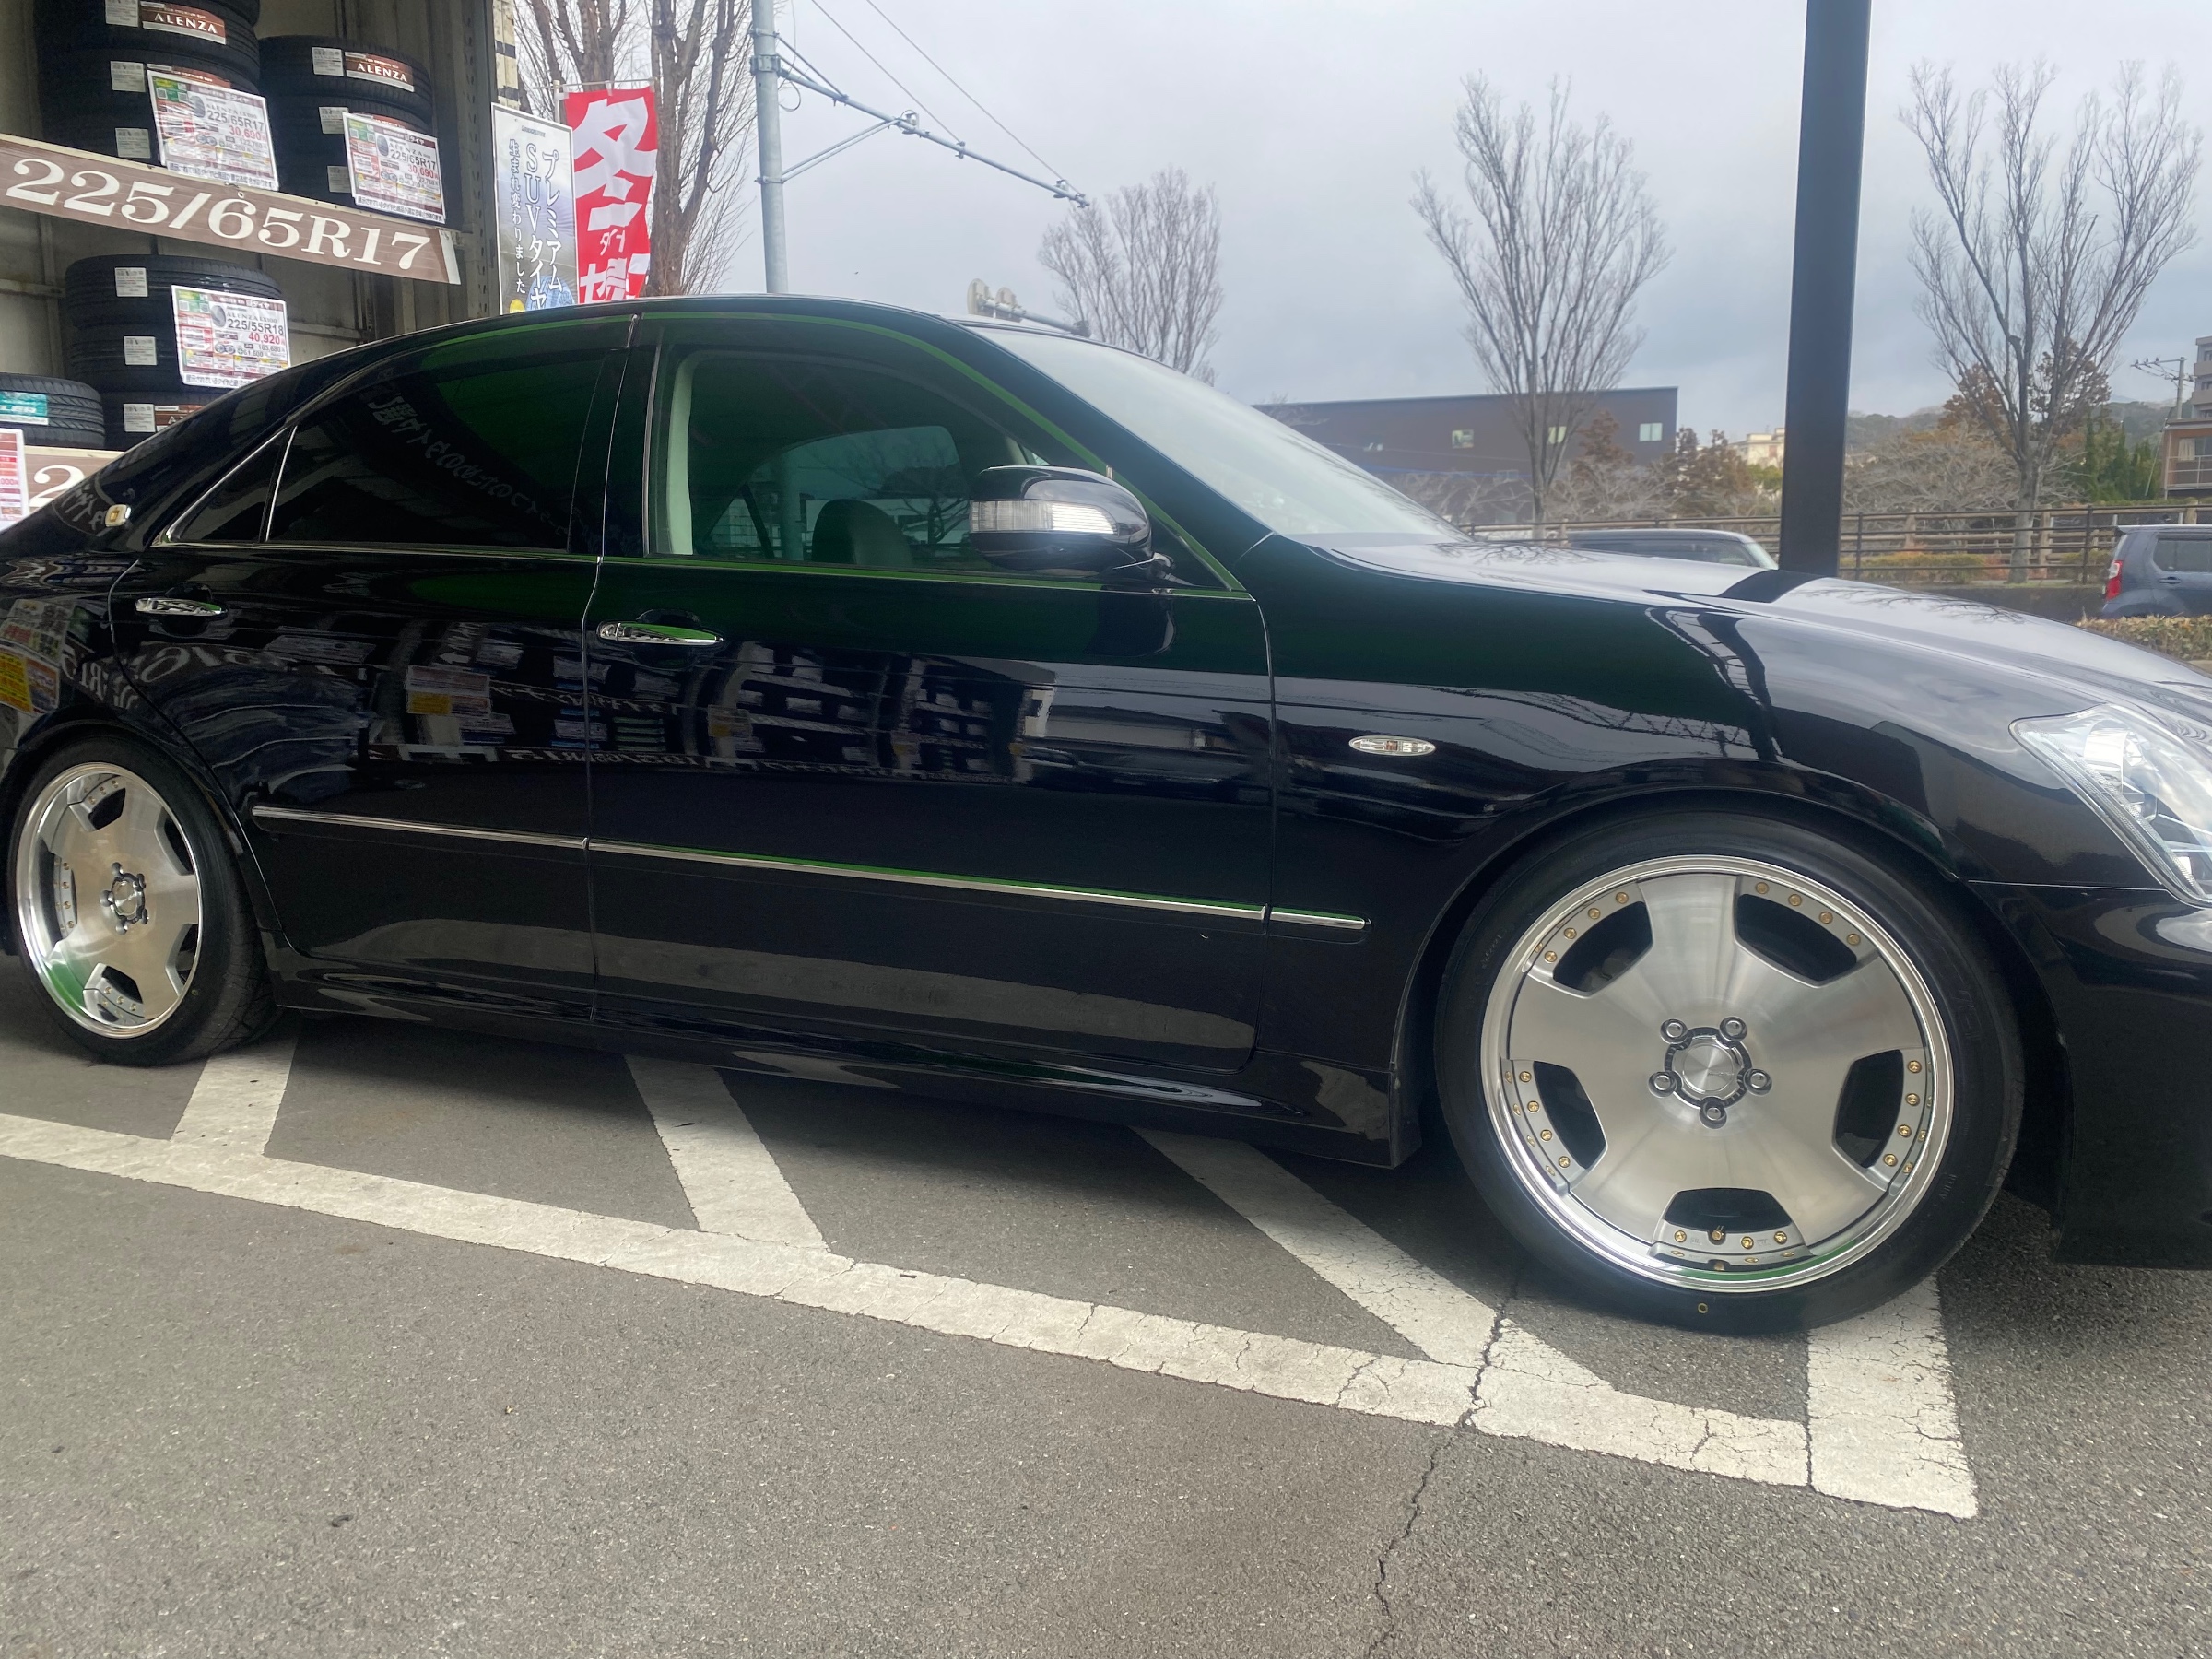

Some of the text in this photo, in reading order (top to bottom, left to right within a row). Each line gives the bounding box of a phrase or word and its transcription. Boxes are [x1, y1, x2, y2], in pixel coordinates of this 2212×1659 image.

[154, 13, 218, 34] ALENZA
[357, 63, 407, 83] ALENZA
[206, 110, 265, 132] 225/65R17
[390, 149, 436, 170] 225/65R17
[6, 158, 430, 270] 225/65R17
[509, 138, 526, 294] 生まれ変わりました
[542, 150, 562, 292] プレミアム
[524, 143, 547, 310] SUVタイヤ
[227, 318, 284, 335] 225/55R18
